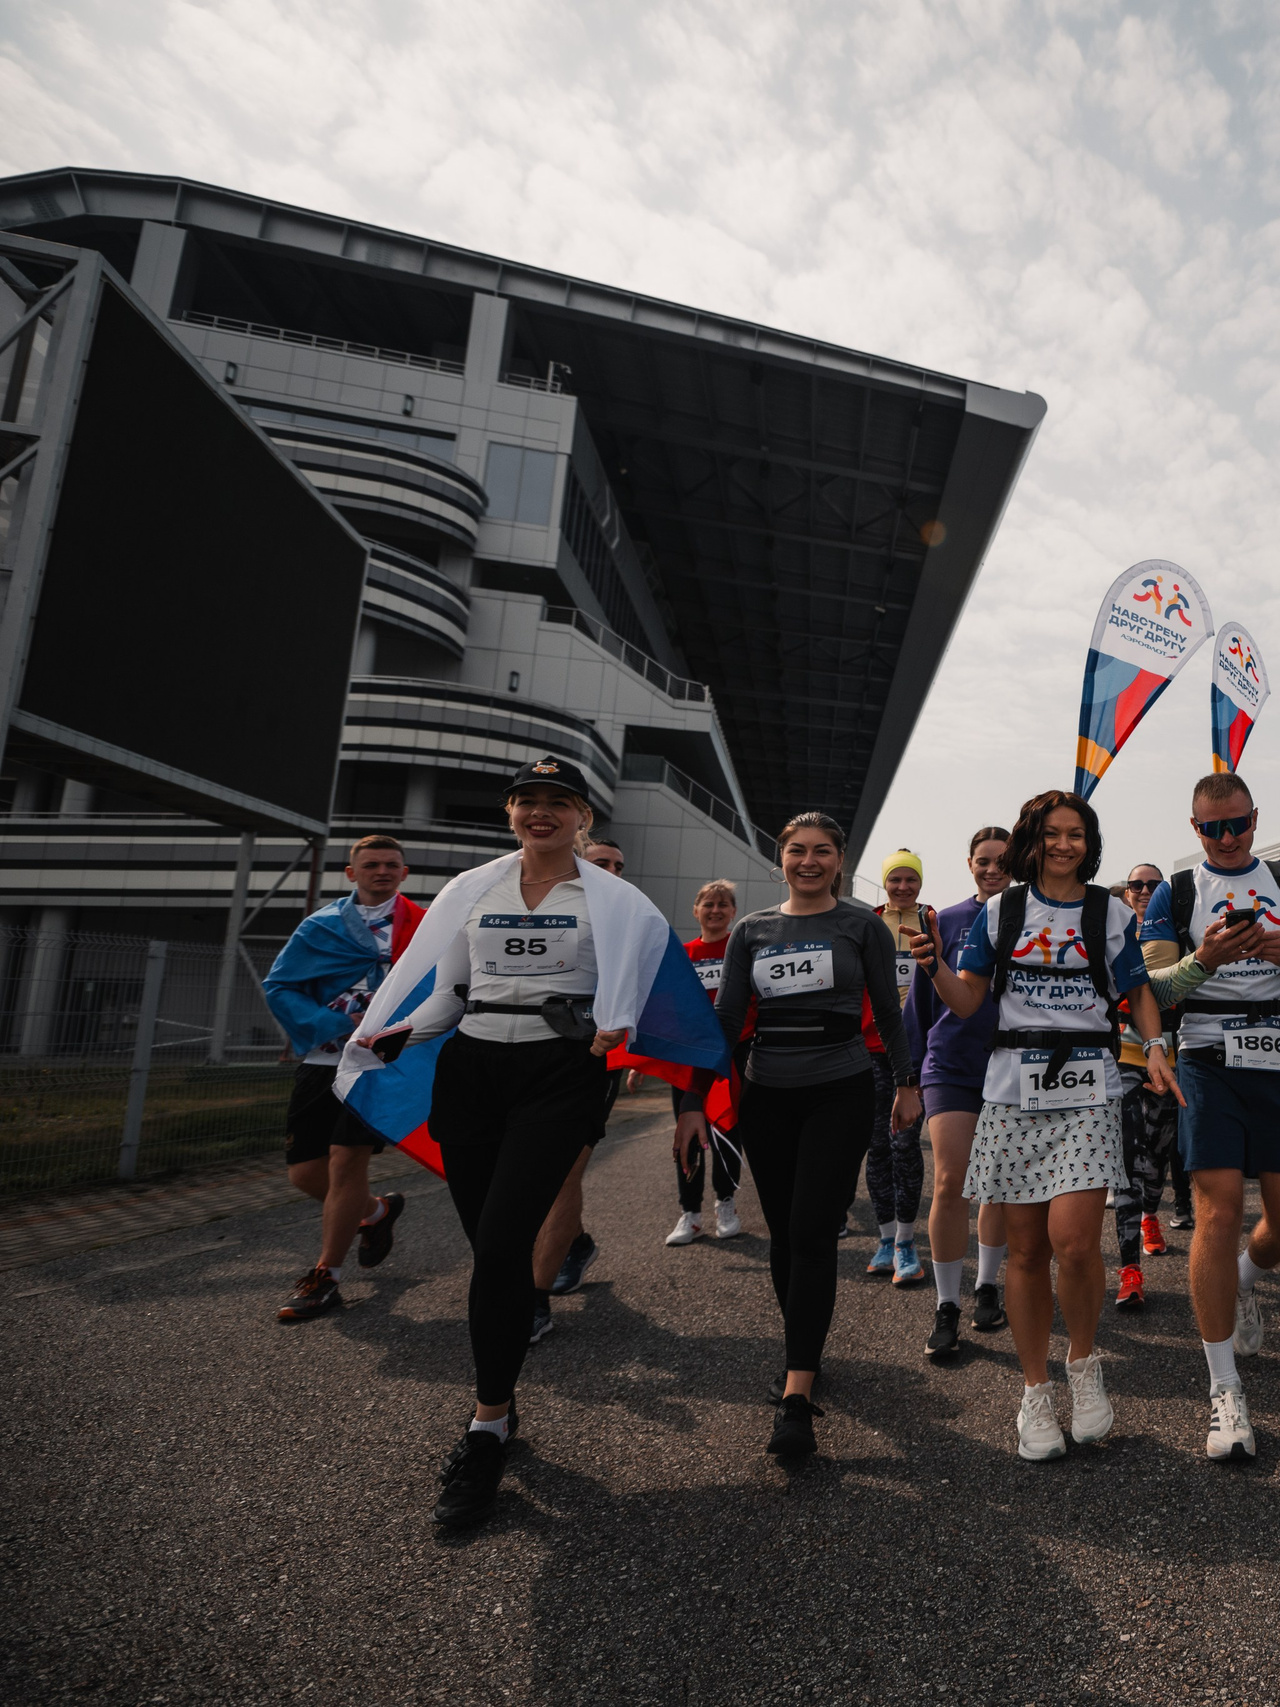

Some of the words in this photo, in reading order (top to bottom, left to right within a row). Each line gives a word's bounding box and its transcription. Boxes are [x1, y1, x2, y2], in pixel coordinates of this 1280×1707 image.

[1112, 603, 1187, 643] НАВСТРЕЧУ
[1109, 614, 1143, 634] ДРУГ
[1144, 630, 1186, 654] ДРУГУ
[1120, 633, 1167, 656] АЭРОФЛОТ
[544, 918, 557, 926] 4,6
[504, 937, 548, 957] 85
[769, 959, 815, 980] 314
[1216, 968, 1279, 980] АЭРОФЛОТ
[1022, 999, 1084, 1011] АЭРОФЛОТ
[1029, 1053, 1041, 1061] 4,6
[1077, 1050, 1088, 1058] 4,6
